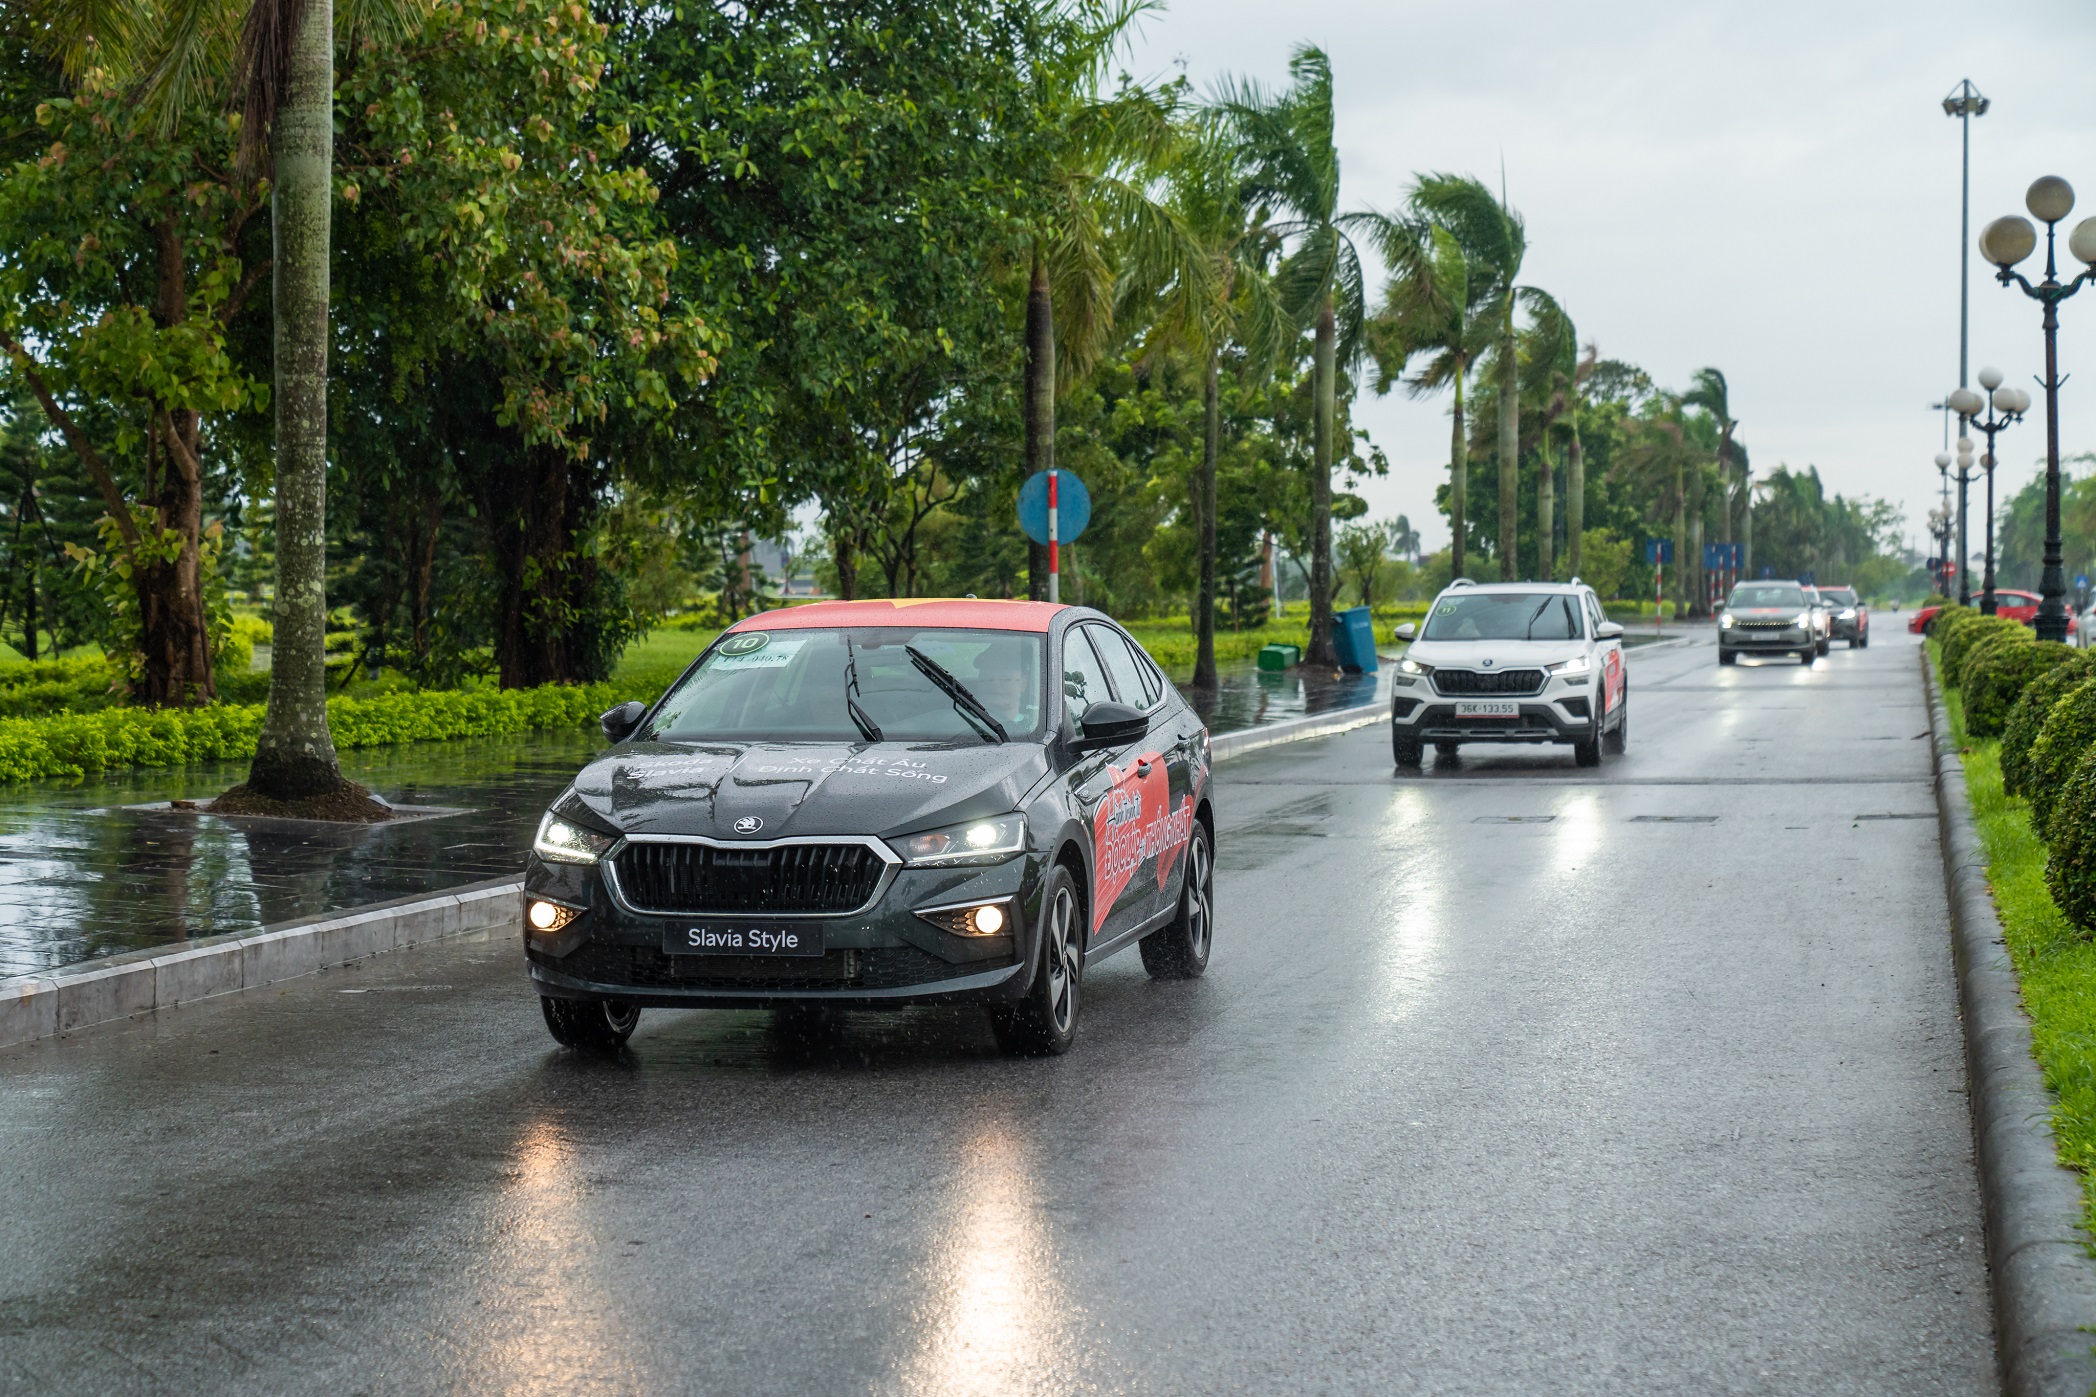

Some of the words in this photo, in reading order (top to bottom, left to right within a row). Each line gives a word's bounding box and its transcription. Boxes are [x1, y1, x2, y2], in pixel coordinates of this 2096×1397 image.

[733, 637, 760, 650] 10
[688, 928, 743, 947] Slavia
[748, 929, 799, 953] Style
